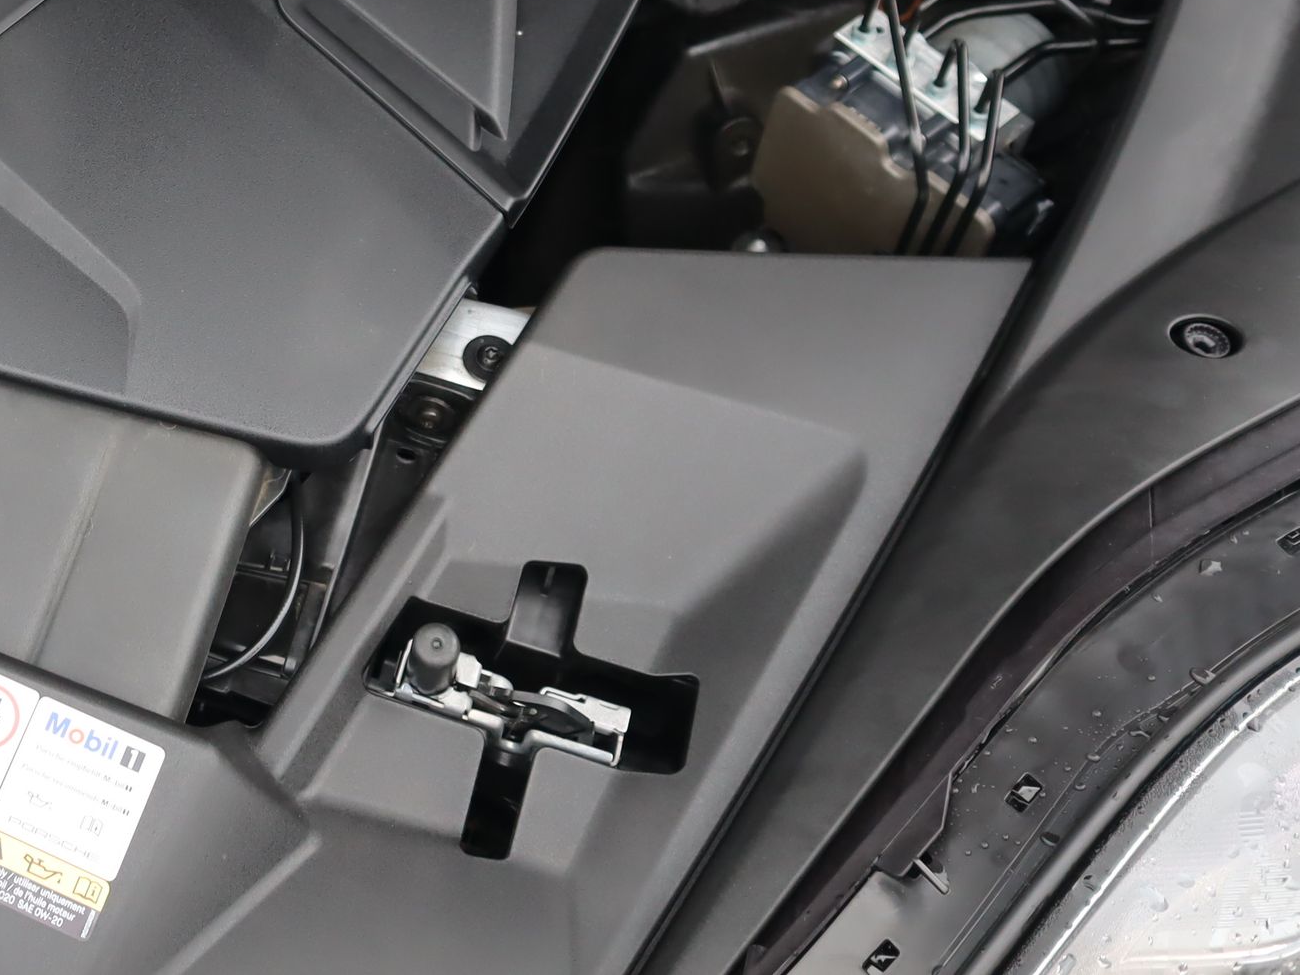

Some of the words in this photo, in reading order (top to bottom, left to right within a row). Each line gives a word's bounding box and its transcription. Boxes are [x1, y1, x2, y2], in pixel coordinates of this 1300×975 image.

[45, 711, 119, 760] Mobil
[123, 747, 143, 772] 1
[13, 874, 40, 893] utiliser
[40, 887, 86, 915] uniquement
[13, 885, 24, 898] de
[47, 902, 76, 921] moteur
[17, 899, 36, 914] SAE
[34, 907, 64, 928] 0W-20
